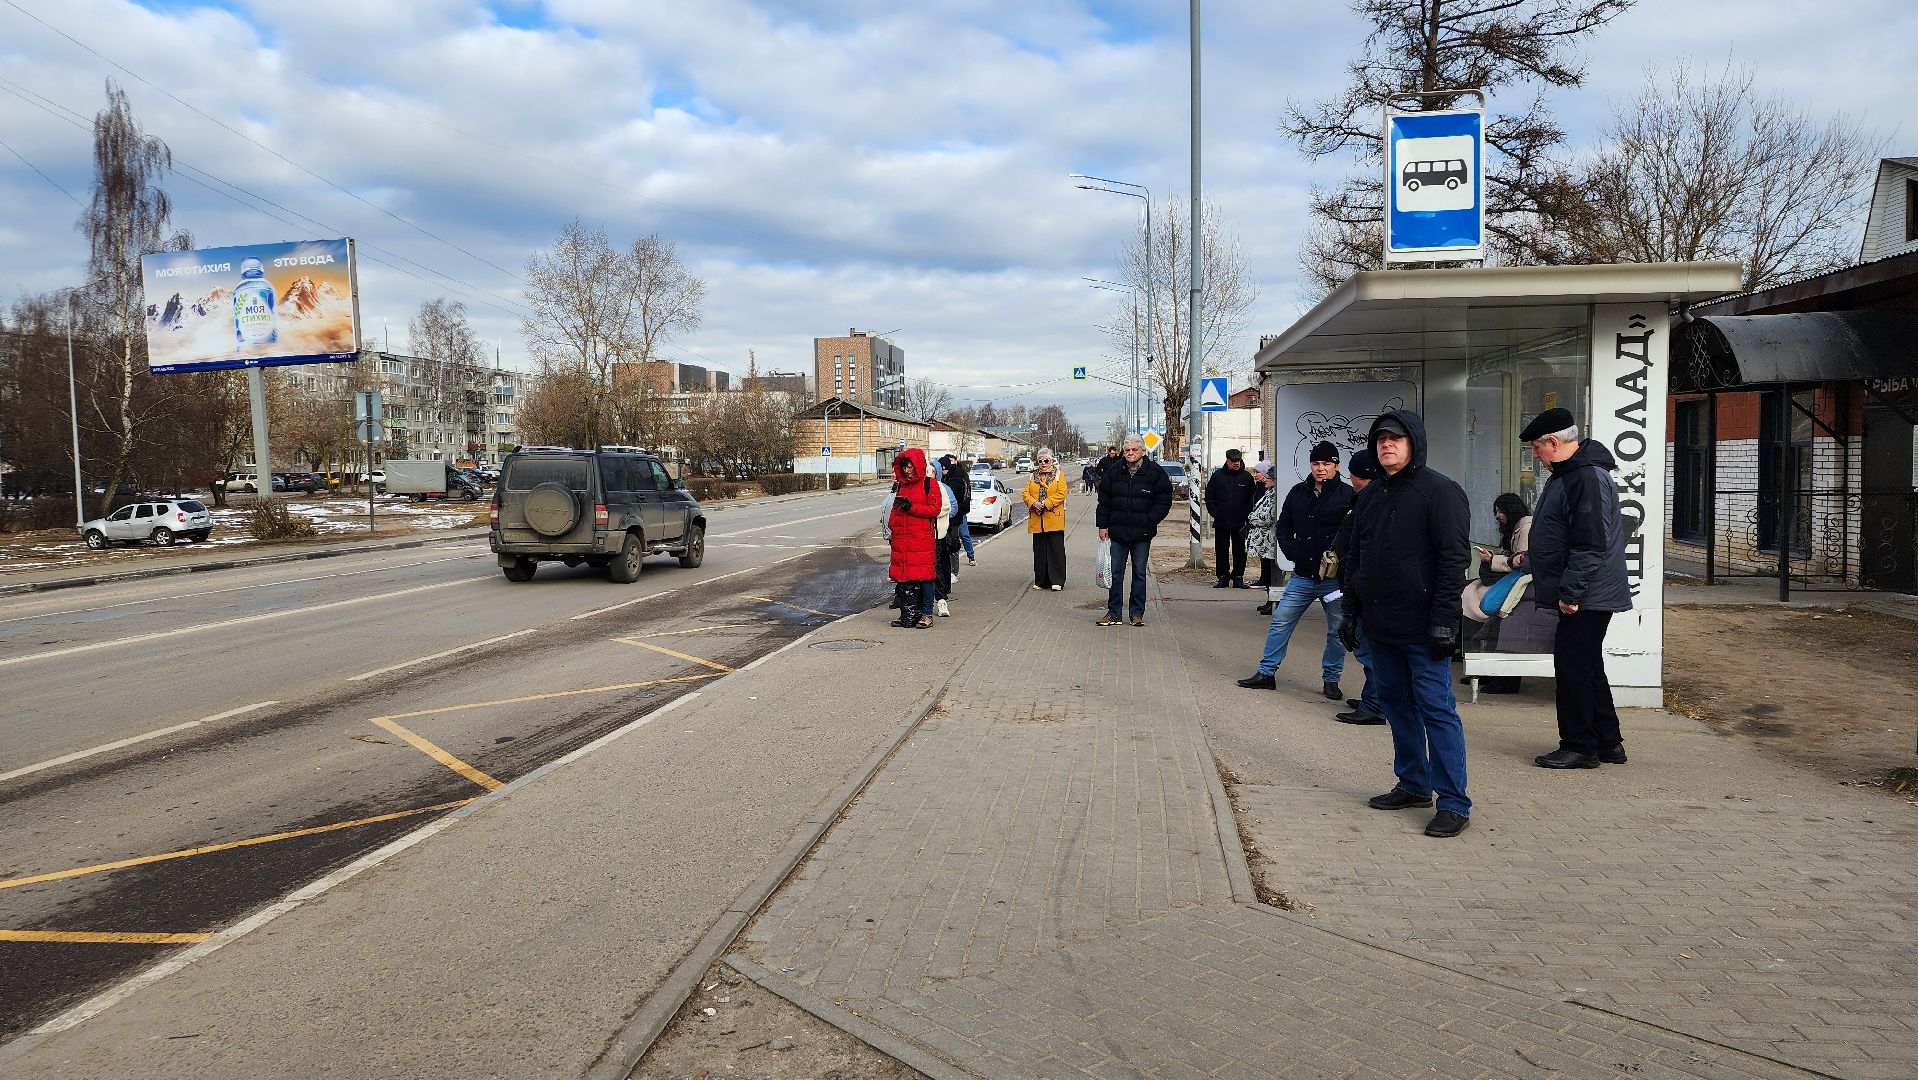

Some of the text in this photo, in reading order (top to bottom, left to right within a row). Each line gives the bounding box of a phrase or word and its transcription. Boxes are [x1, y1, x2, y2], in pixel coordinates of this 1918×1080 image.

[273, 254, 335, 268] ЭТО ВОДА
[155, 267, 183, 278] МОЯ
[245, 305, 265, 315] МОЯ
